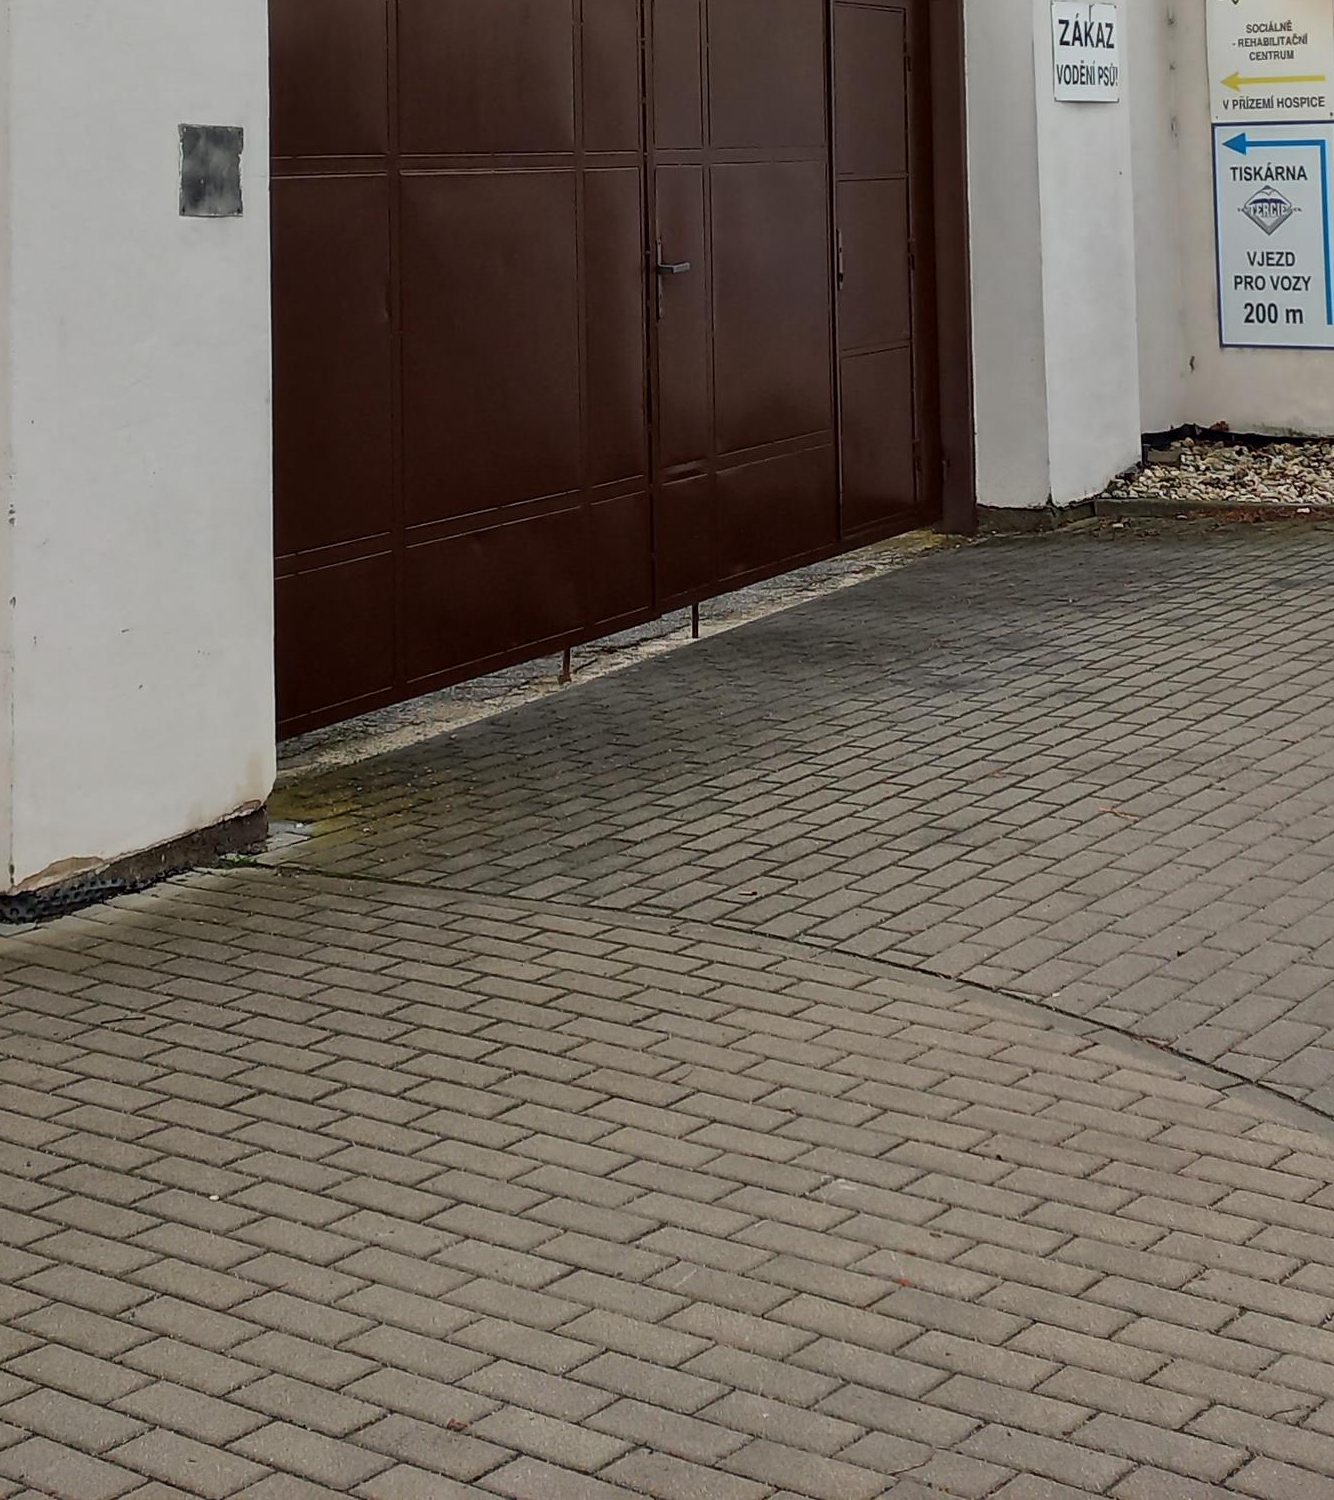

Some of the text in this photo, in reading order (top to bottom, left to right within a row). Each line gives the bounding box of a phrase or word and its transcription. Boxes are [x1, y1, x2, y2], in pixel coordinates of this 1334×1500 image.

[1058, 12, 1115, 49] ZÁKAZ
[1246, 20, 1293, 33] SOCIÁLNĚ
[1249, 50, 1295, 61] CENTRUM
[1056, 60, 1118, 86] VODĚNÍ PSŮ!
[1223, 95, 1325, 110] V PŘÍZEMÍ HOSPICE
[1230, 162, 1308, 181] TISKÁRNA
[1250, 203, 1287, 217] TERCIE
[1247, 251, 1295, 267] VJEZD
[1234, 275, 1311, 291] PRO VOZY
[1244, 303, 1304, 324] 200 m
